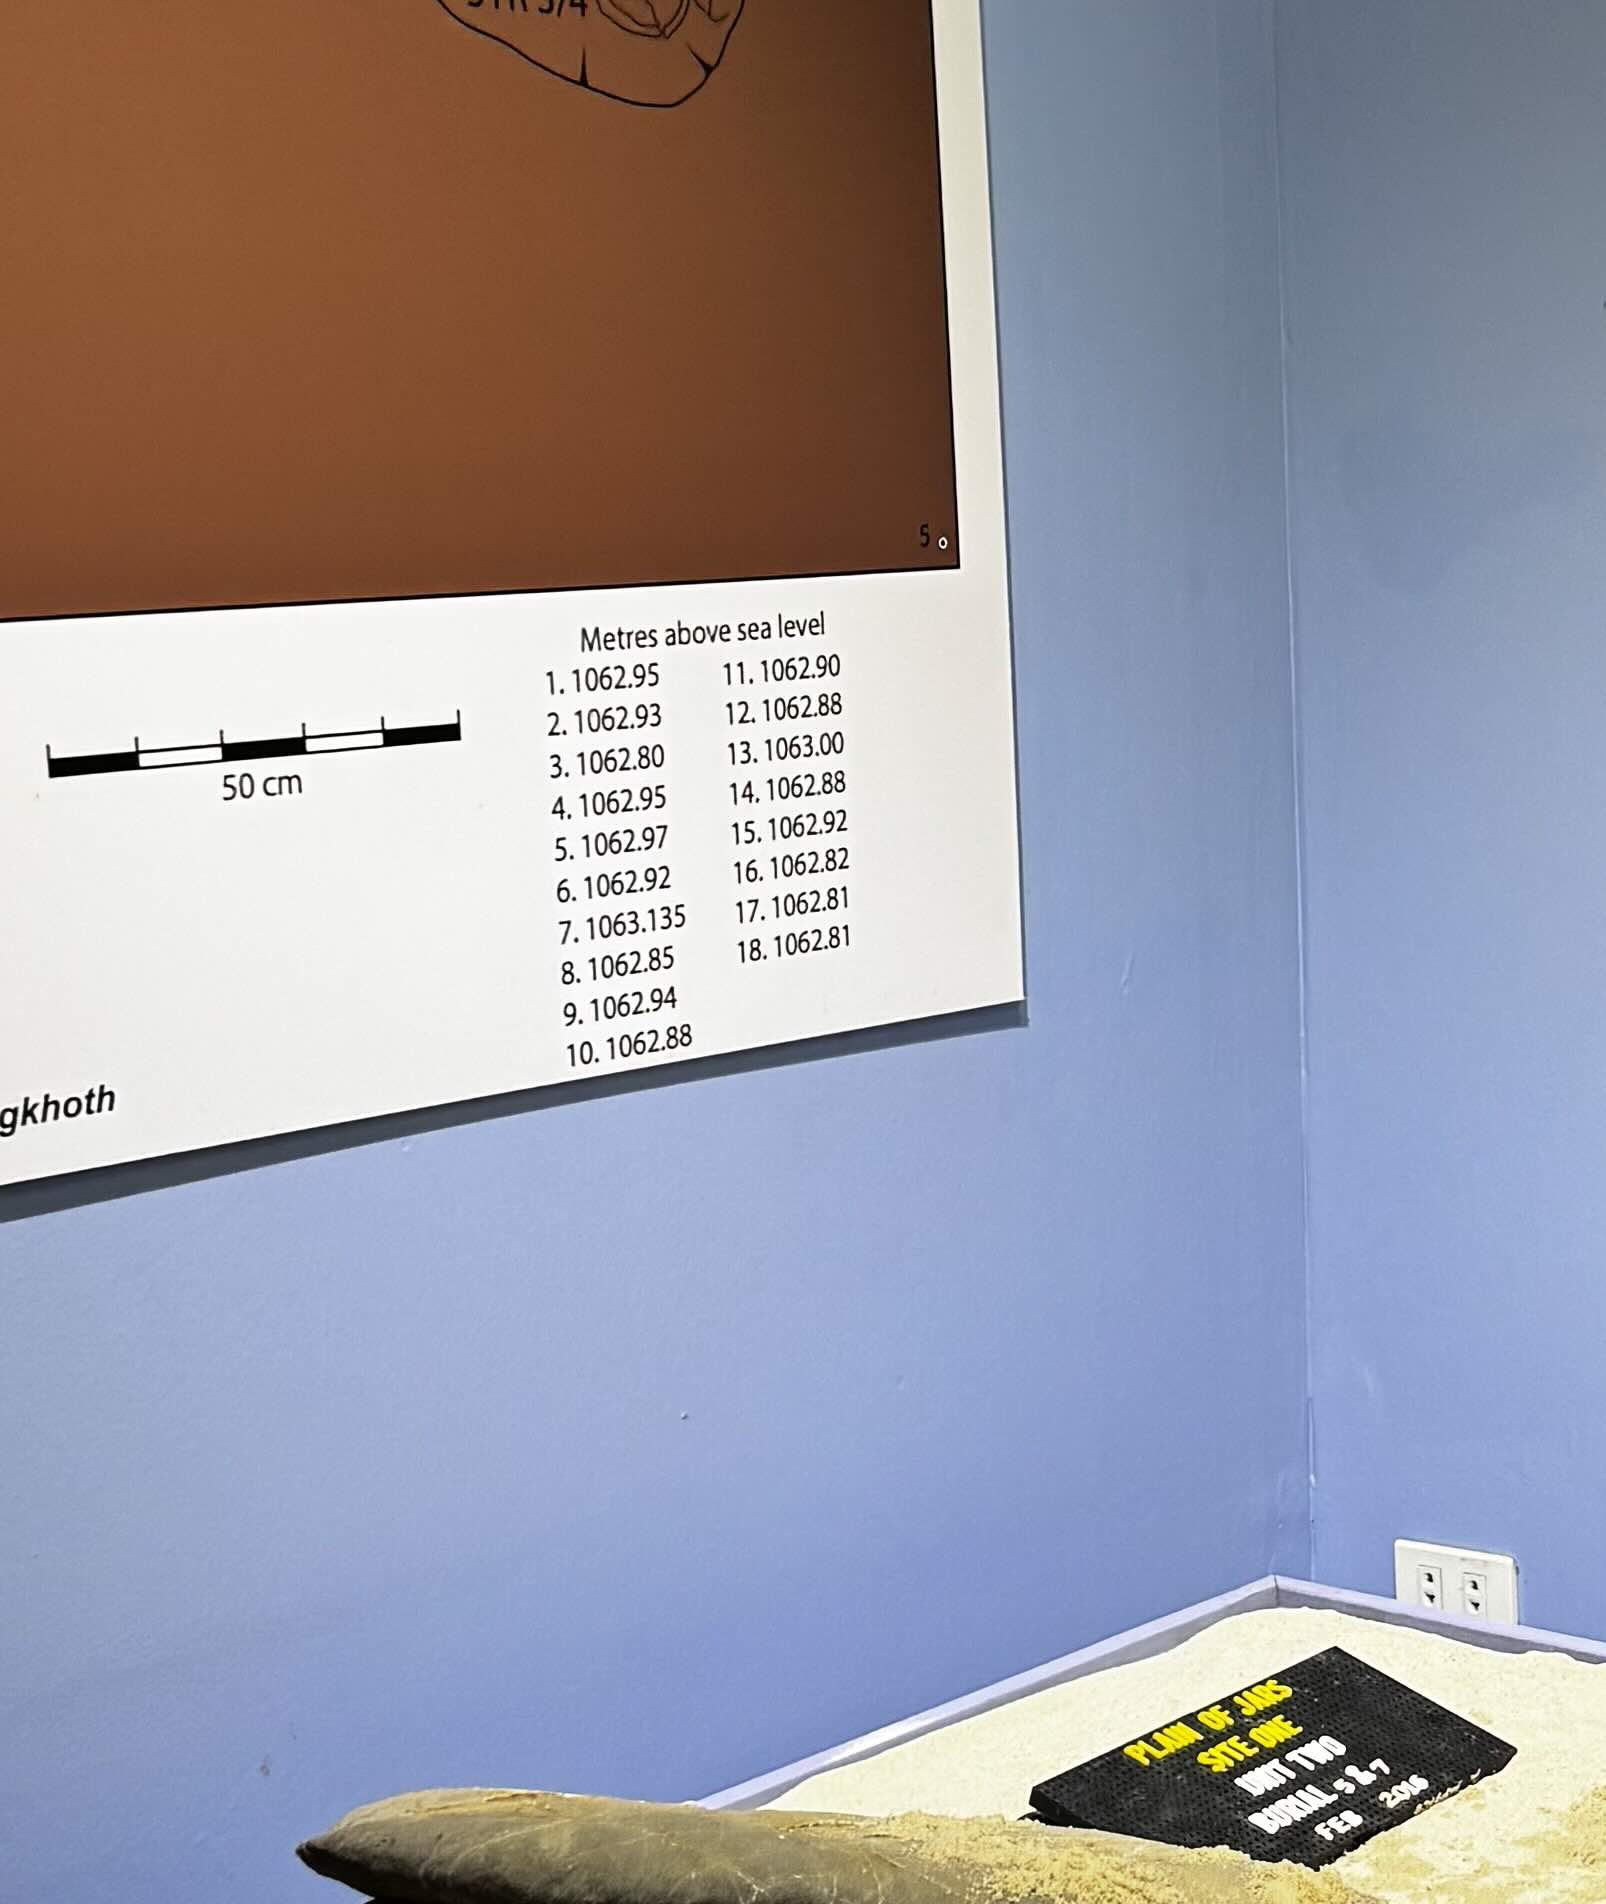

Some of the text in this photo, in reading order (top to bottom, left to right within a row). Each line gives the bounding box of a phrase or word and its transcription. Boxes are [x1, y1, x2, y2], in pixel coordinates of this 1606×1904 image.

[920, 523, 930, 548] 5
[581, 611, 825, 653] Metres above sea level
[546, 662, 660, 695] 1. 1062.95
[723, 654, 841, 686] 11. 1062.90
[547, 703, 662, 736] 2. 1062.93
[725, 692, 843, 726] 12. 1062.88
[549, 743, 665, 779] 3. 1062.80
[727, 731, 845, 766] 13. 1063.00
[222, 772, 303, 801] 50 cm
[551, 784, 666, 820] 4. 1062.95
[729, 770, 846, 806] 14. 1062.88
[554, 824, 668, 861] 5. 1062.97
[731, 809, 848, 846] 15. 1062.92
[556, 865, 672, 903] 6. 1062.92
[733, 847, 850, 885] 16. 1062.82
[558, 903, 686, 945] 7. 1063.135
[735, 886, 849, 925] 17. 1062.81
[737, 924, 851, 964] 18. 1062.81
[561, 945, 674, 985] 8. 1062.85
[563, 986, 677, 1026] 9. 1062.94
[566, 1023, 693, 1067] 10. 1062.88
[1122, 1679, 1293, 1767] PLAIN OF JARS
[1196, 1713, 1304, 1775] SITE ONE
[1234, 1733, 1348, 1798] UNIT TWO
[1247, 1757, 1391, 1836] BURIAL 5 & 7
[1313, 1774, 1430, 1841] FEB 2016
